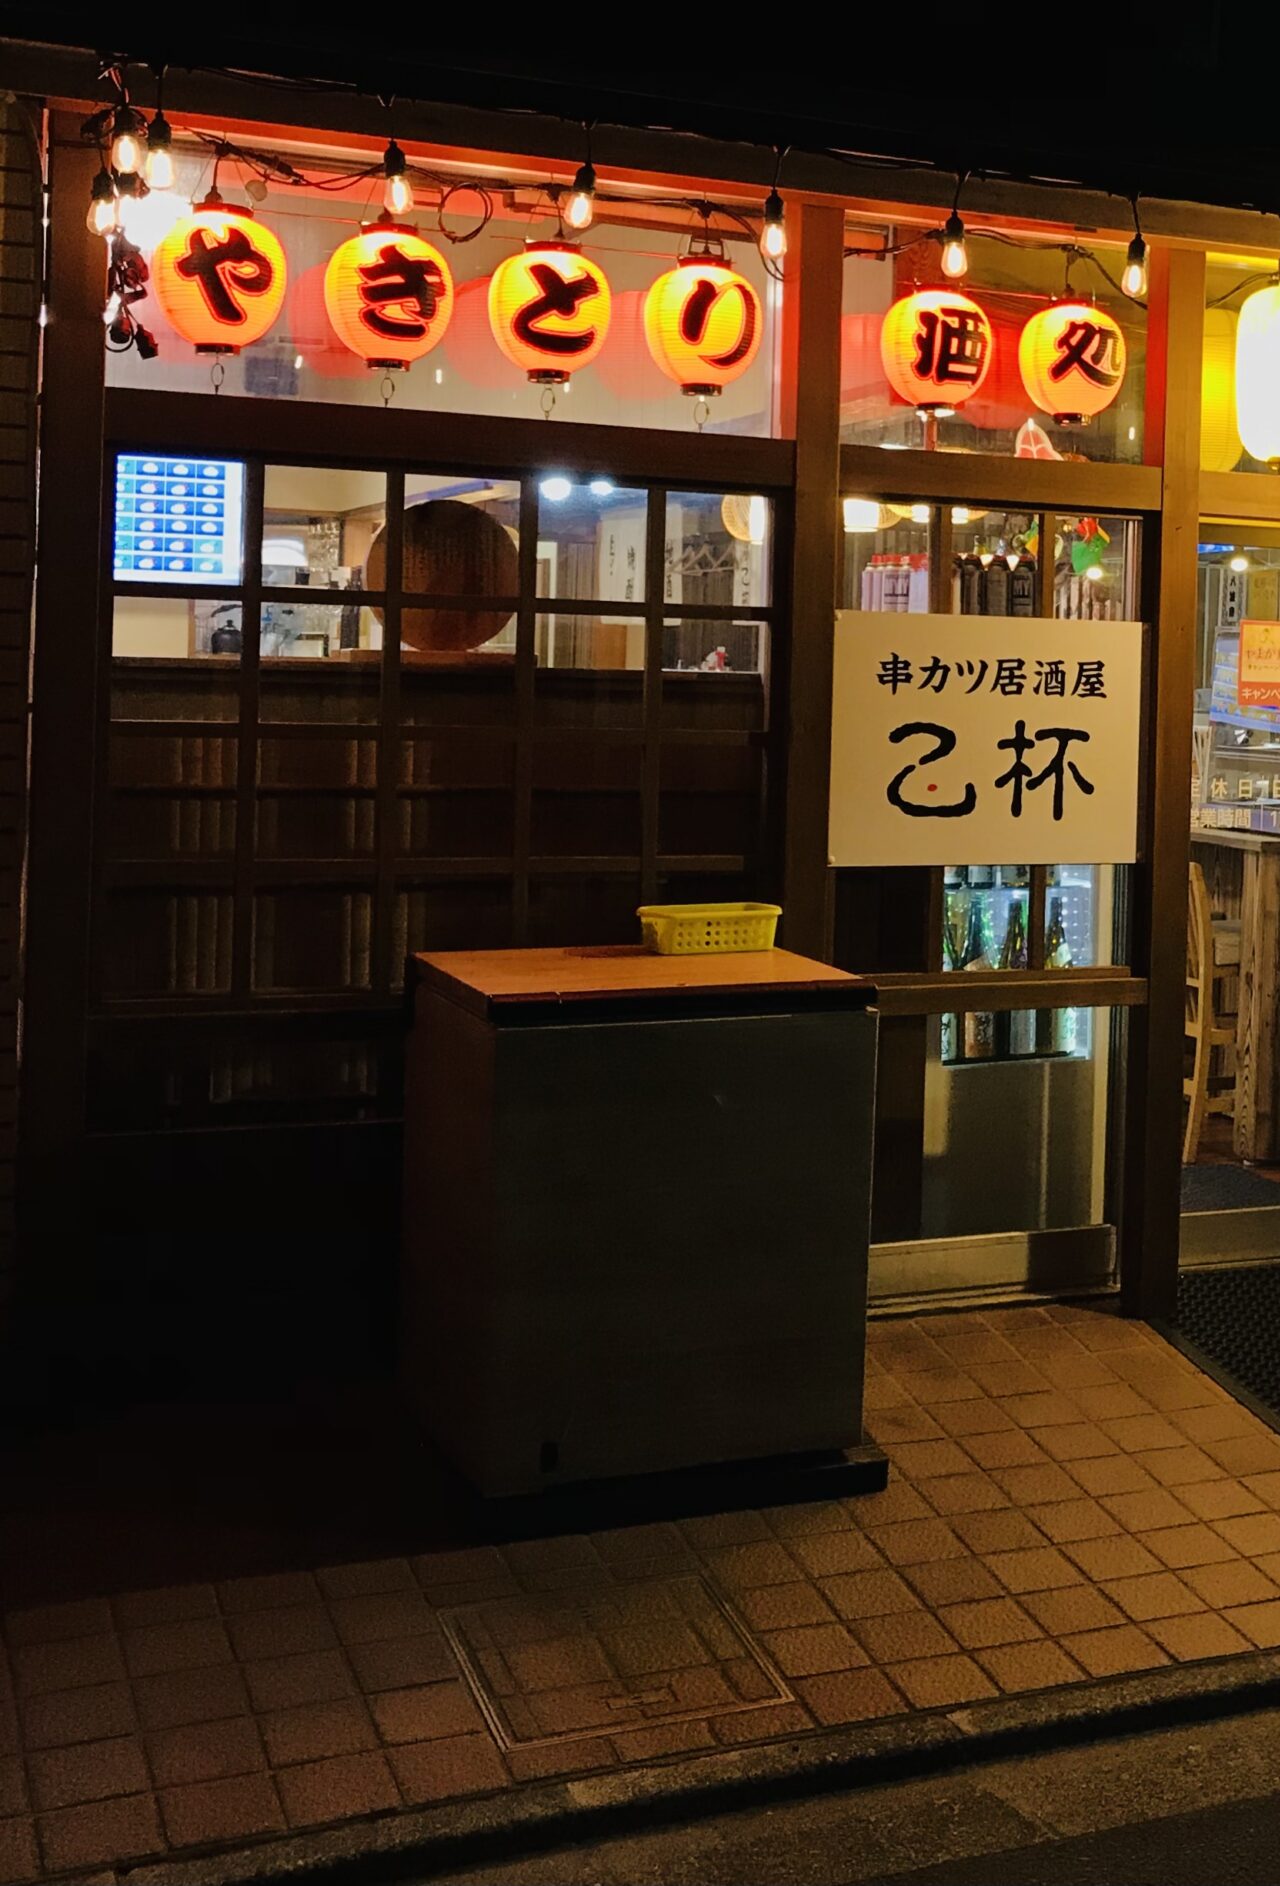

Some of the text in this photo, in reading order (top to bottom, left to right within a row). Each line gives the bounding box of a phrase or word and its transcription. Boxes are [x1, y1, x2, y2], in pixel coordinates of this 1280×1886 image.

[876, 652, 1107, 699] 串カツ居酒屋
